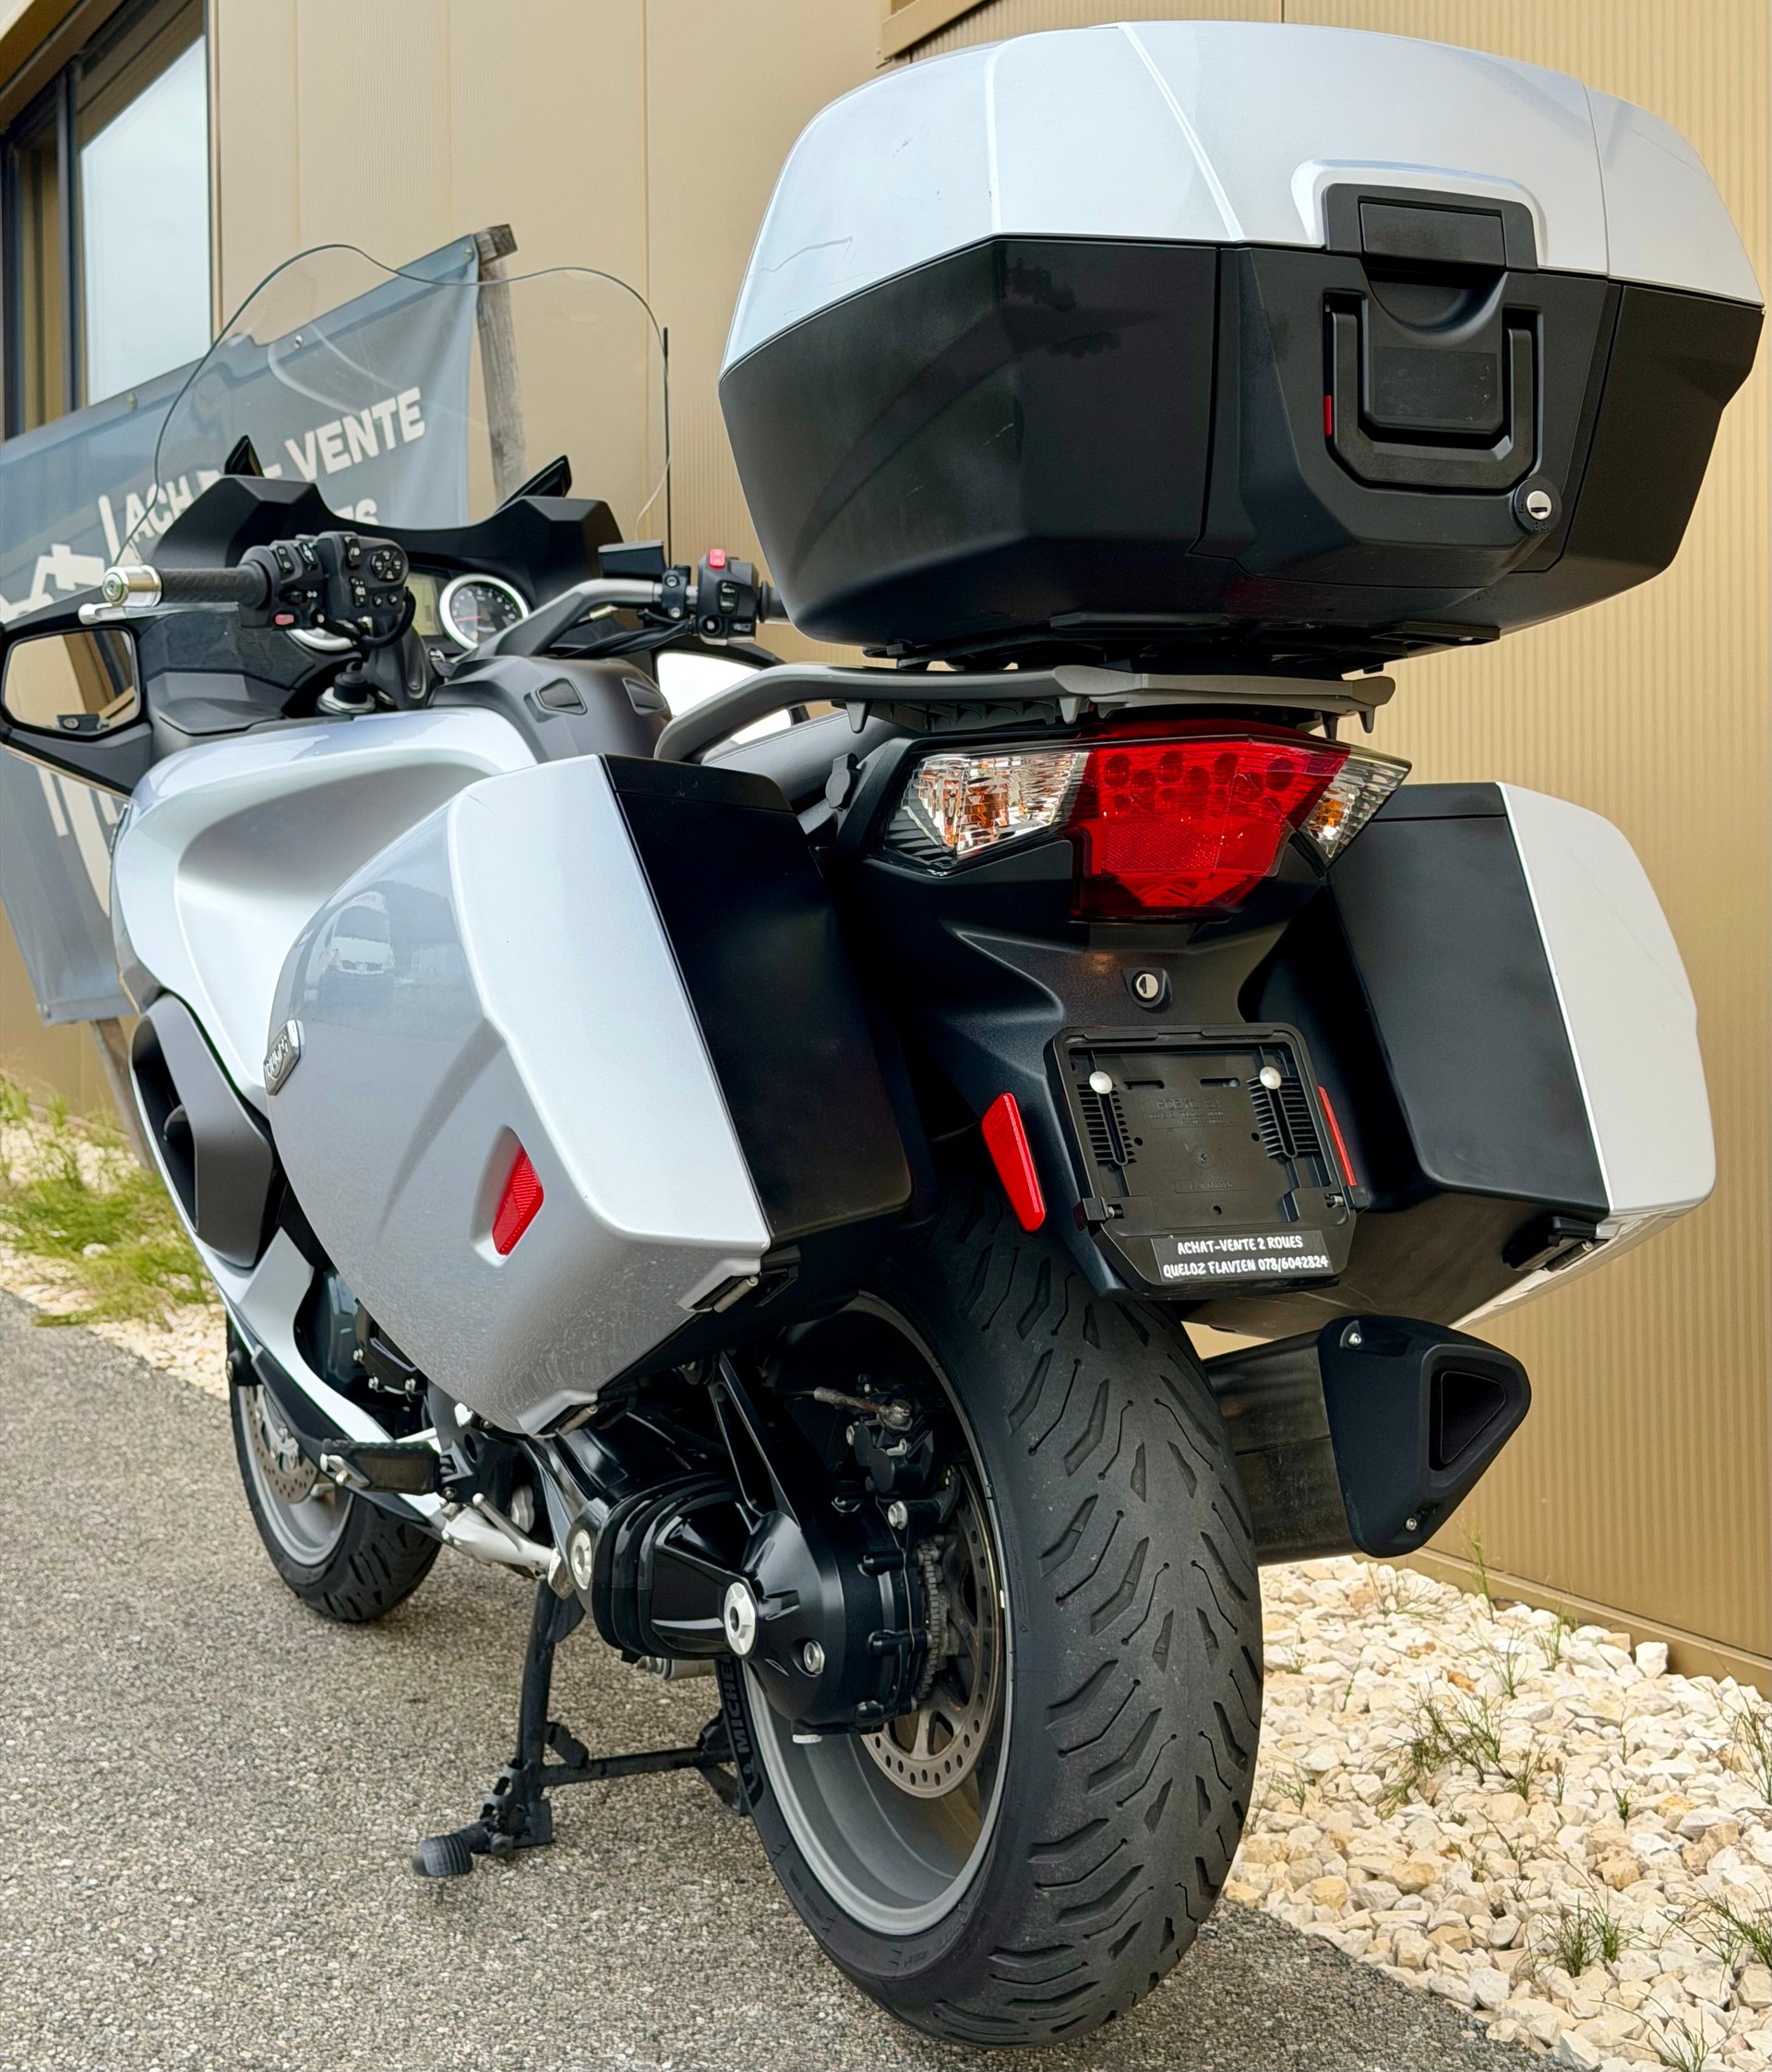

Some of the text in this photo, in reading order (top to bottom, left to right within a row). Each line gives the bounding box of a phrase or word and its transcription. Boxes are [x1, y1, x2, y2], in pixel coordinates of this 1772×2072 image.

[284, 386, 425, 482] VENTE
[1163, 1254, 1329, 1279] QUELOZ FLAVIEN 078/6042824
[1177, 1235, 1303, 1255] ACHAT-VENTE 2 ROUES
[721, 1655, 750, 1754] MICHE
